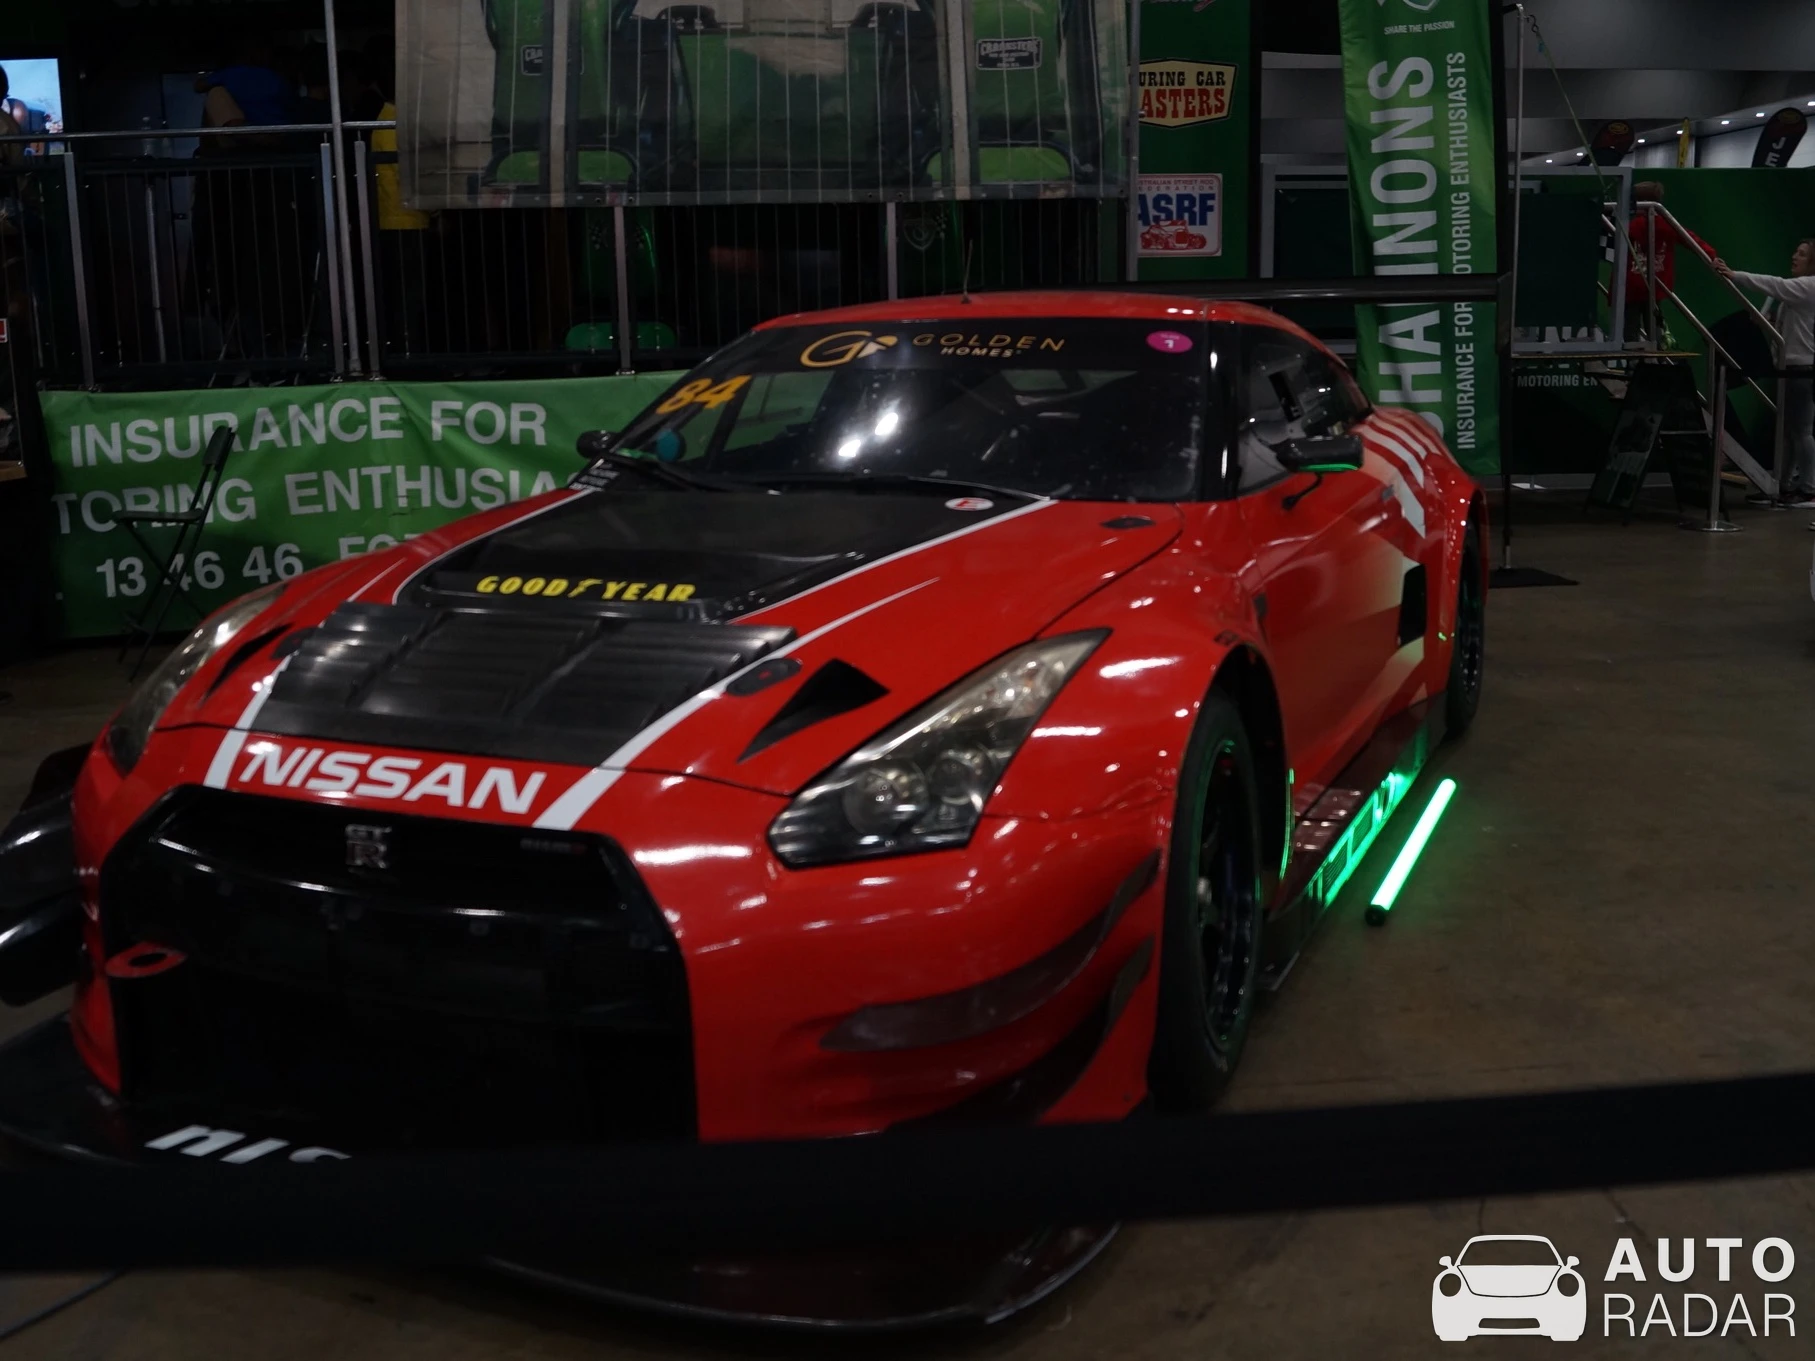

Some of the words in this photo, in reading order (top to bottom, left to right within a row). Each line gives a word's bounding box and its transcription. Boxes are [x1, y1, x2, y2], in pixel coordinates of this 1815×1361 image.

[1424, 20, 1455, 31] PASSION
[1139, 72, 1185, 86] URING
[1197, 71, 1226, 86] CAR
[1140, 88, 1225, 118] ASTERS
[1446, 52, 1470, 185] ENTHUSIASTS
[1138, 193, 1216, 226] ASRF
[1451, 192, 1472, 275] OTORING
[912, 333, 1065, 352] GOLDEN
[940, 346, 1013, 359] HOMES
[655, 374, 752, 415] 84
[1455, 342, 1476, 449] INSURANCE
[1517, 374, 1580, 387] MOTORING
[70, 396, 404, 468] INSURANCE
[431, 400, 547, 446] FOR
[51, 478, 257, 535] TORING
[285, 465, 578, 516] ENTHUSIA
[96, 557, 148, 599] 13
[163, 550, 226, 592] 46
[242, 543, 305, 585] 46
[238, 742, 548, 815] NISSAN
